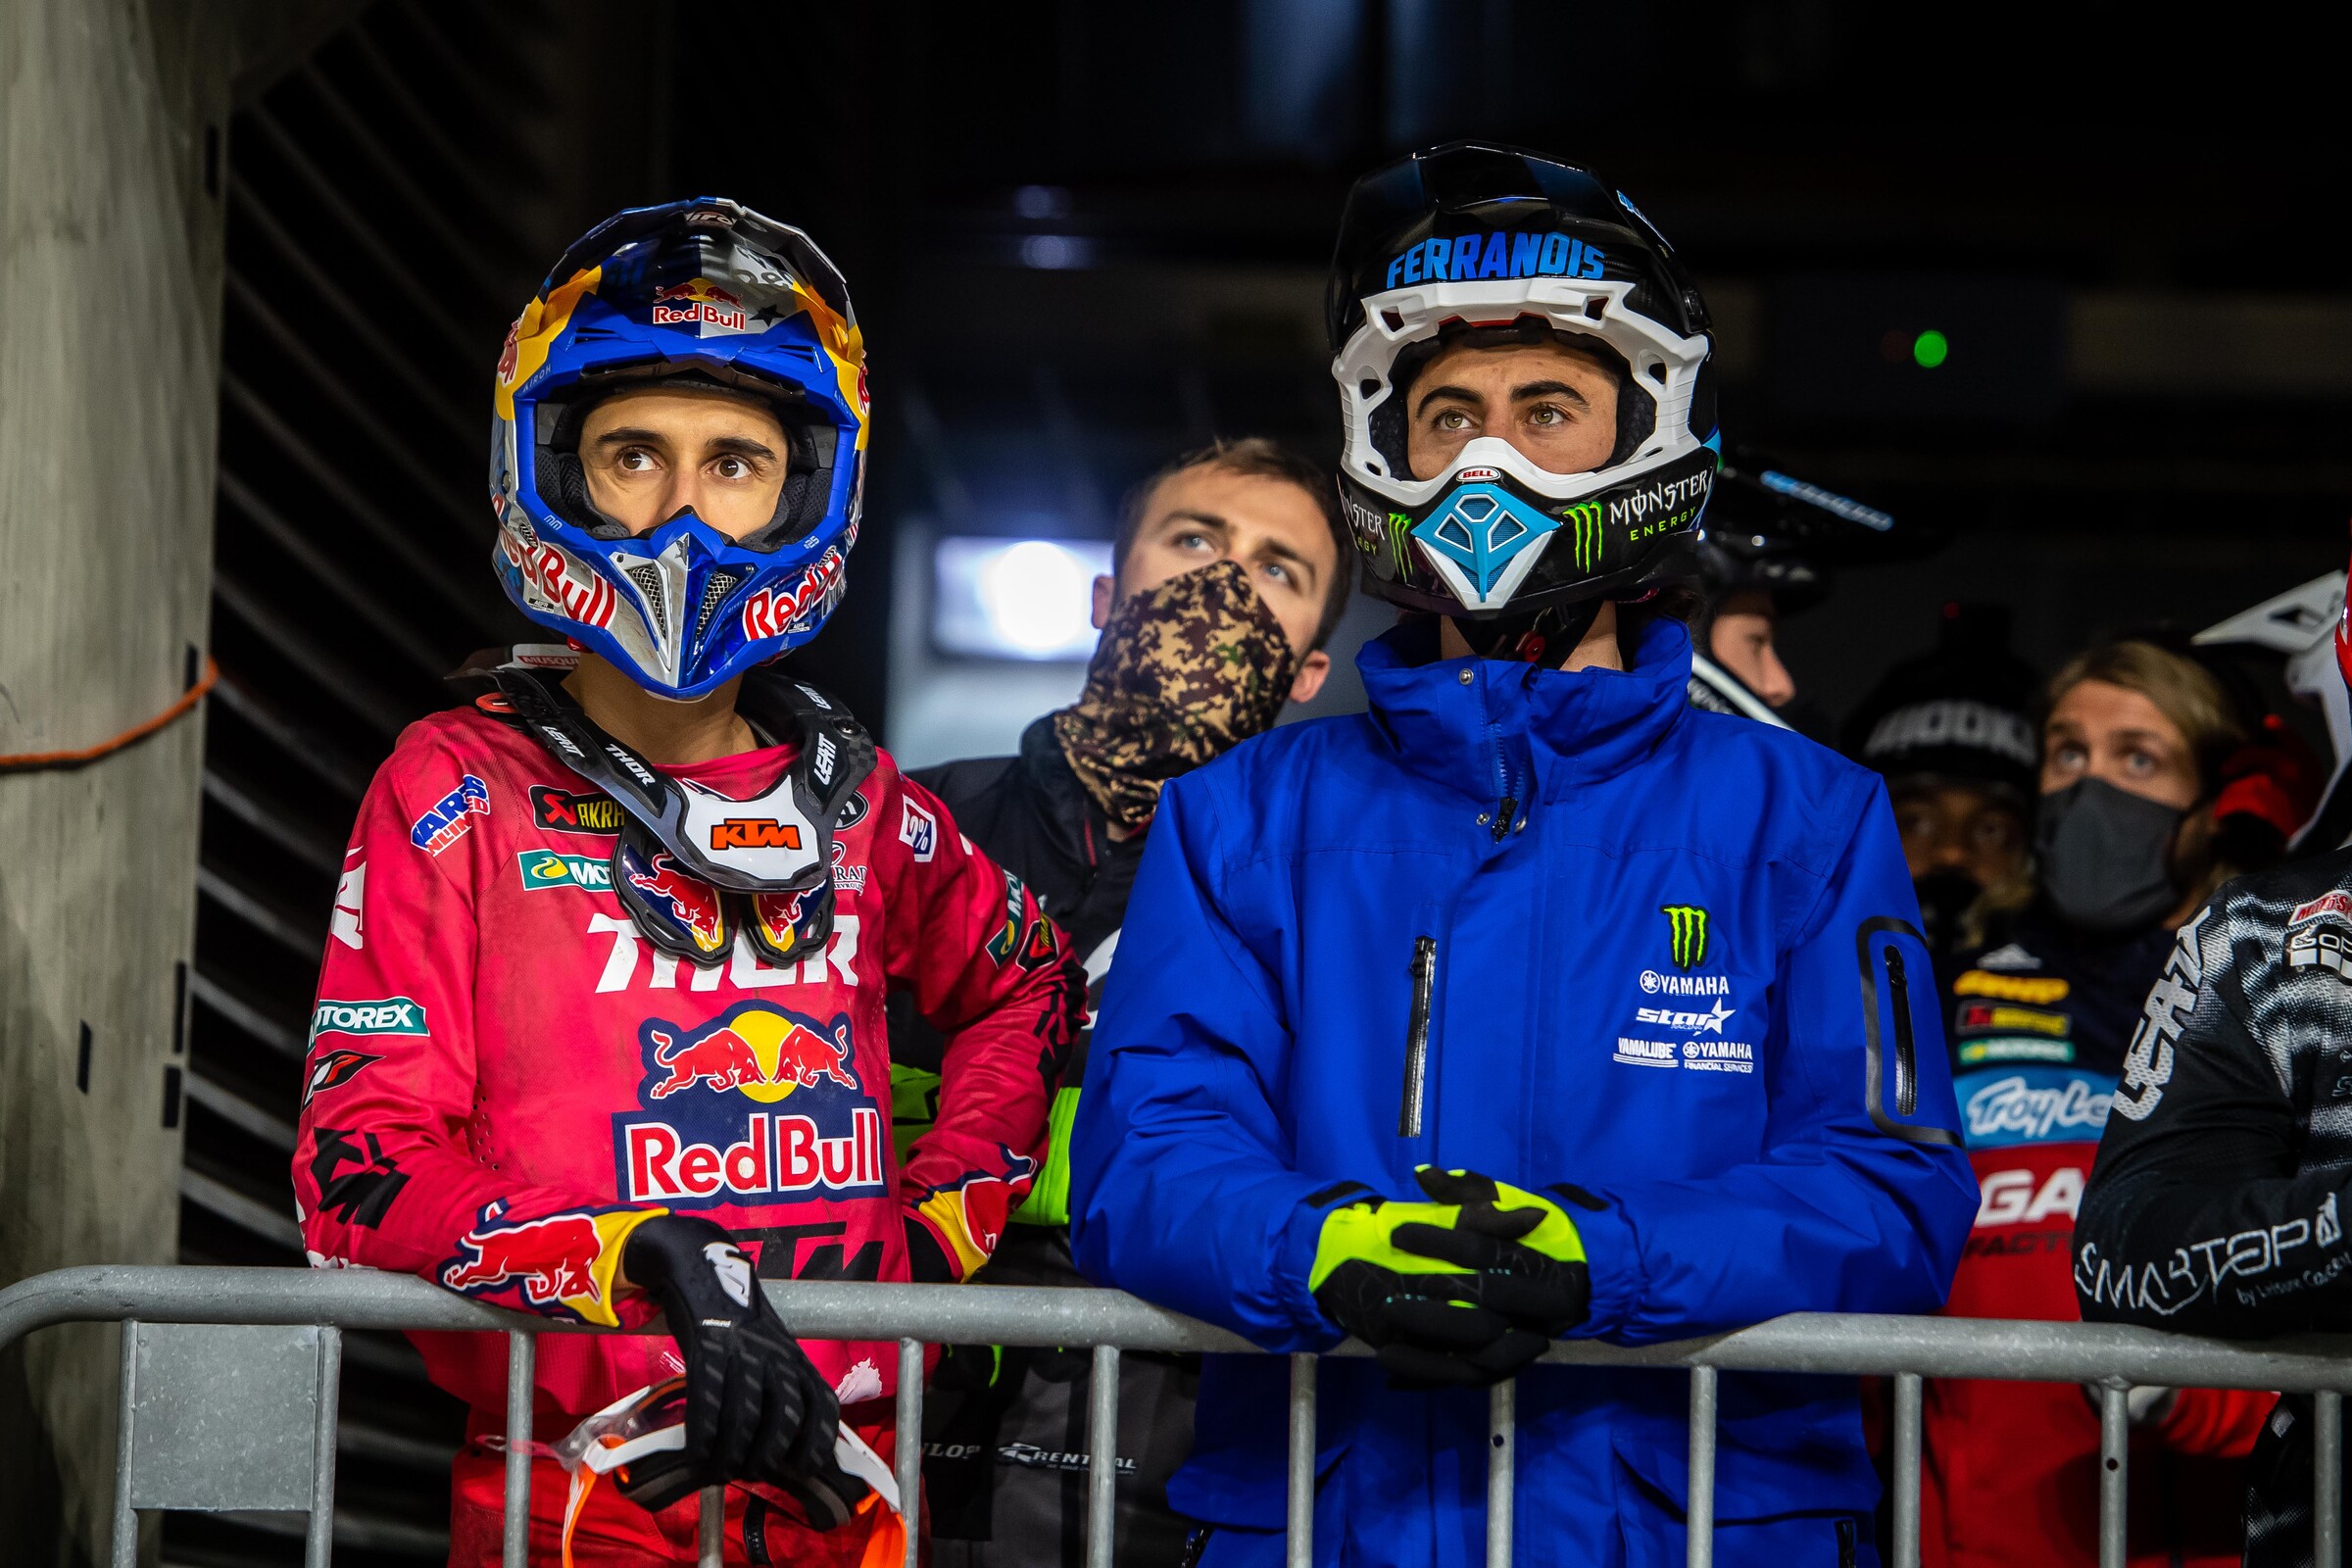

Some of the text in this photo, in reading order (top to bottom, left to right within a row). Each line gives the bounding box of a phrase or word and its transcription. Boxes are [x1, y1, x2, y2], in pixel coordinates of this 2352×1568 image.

[653, 302, 746, 330] Red Bull
[1630, 506, 1696, 541] ENERGY
[538, 541, 616, 628] Bull
[744, 563, 818, 641] Red
[542, 725, 585, 759] LEATT
[813, 732, 837, 786] LEATT
[605, 743, 656, 788] THOR
[710, 817, 802, 850] KTM
[1660, 975, 1730, 996] YAMAHA
[1618, 1037, 1677, 1058] YAMALUBE
[1698, 1042, 1753, 1060] YAMAHA
[628, 1108, 884, 1200] Red Bull
[1033, 1449, 1137, 1470] RENTAL
